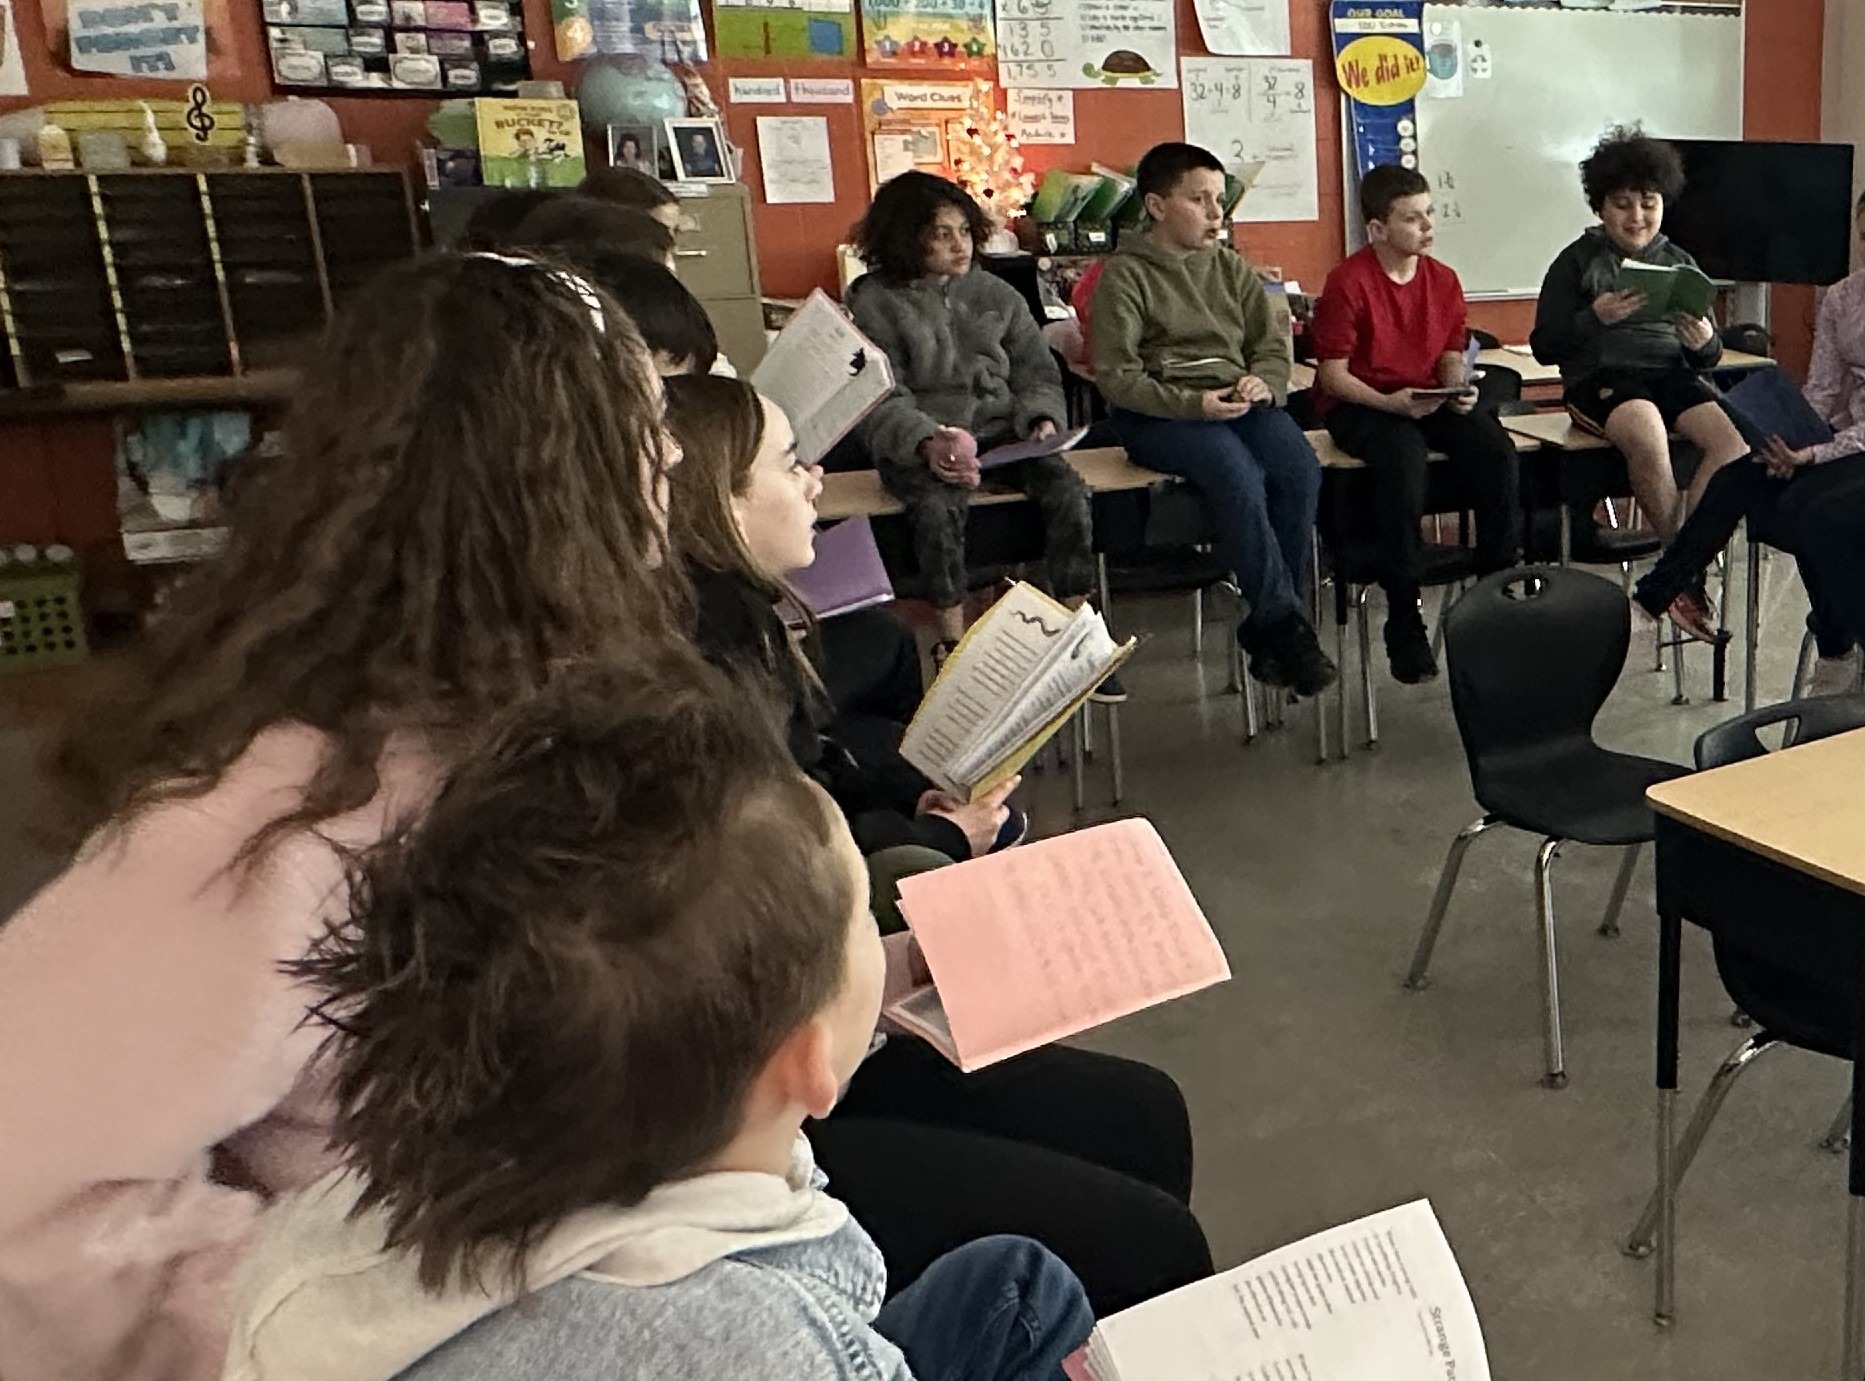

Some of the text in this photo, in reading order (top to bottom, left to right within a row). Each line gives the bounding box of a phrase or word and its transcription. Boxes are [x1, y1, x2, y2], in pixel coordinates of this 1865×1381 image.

[1346, 8, 1405, 18] OUR GOAL
[1342, 53, 1420, 89] We did it!
[895, 92, 962, 103] Word Clues
[1429, 1304, 1452, 1358] Strange
